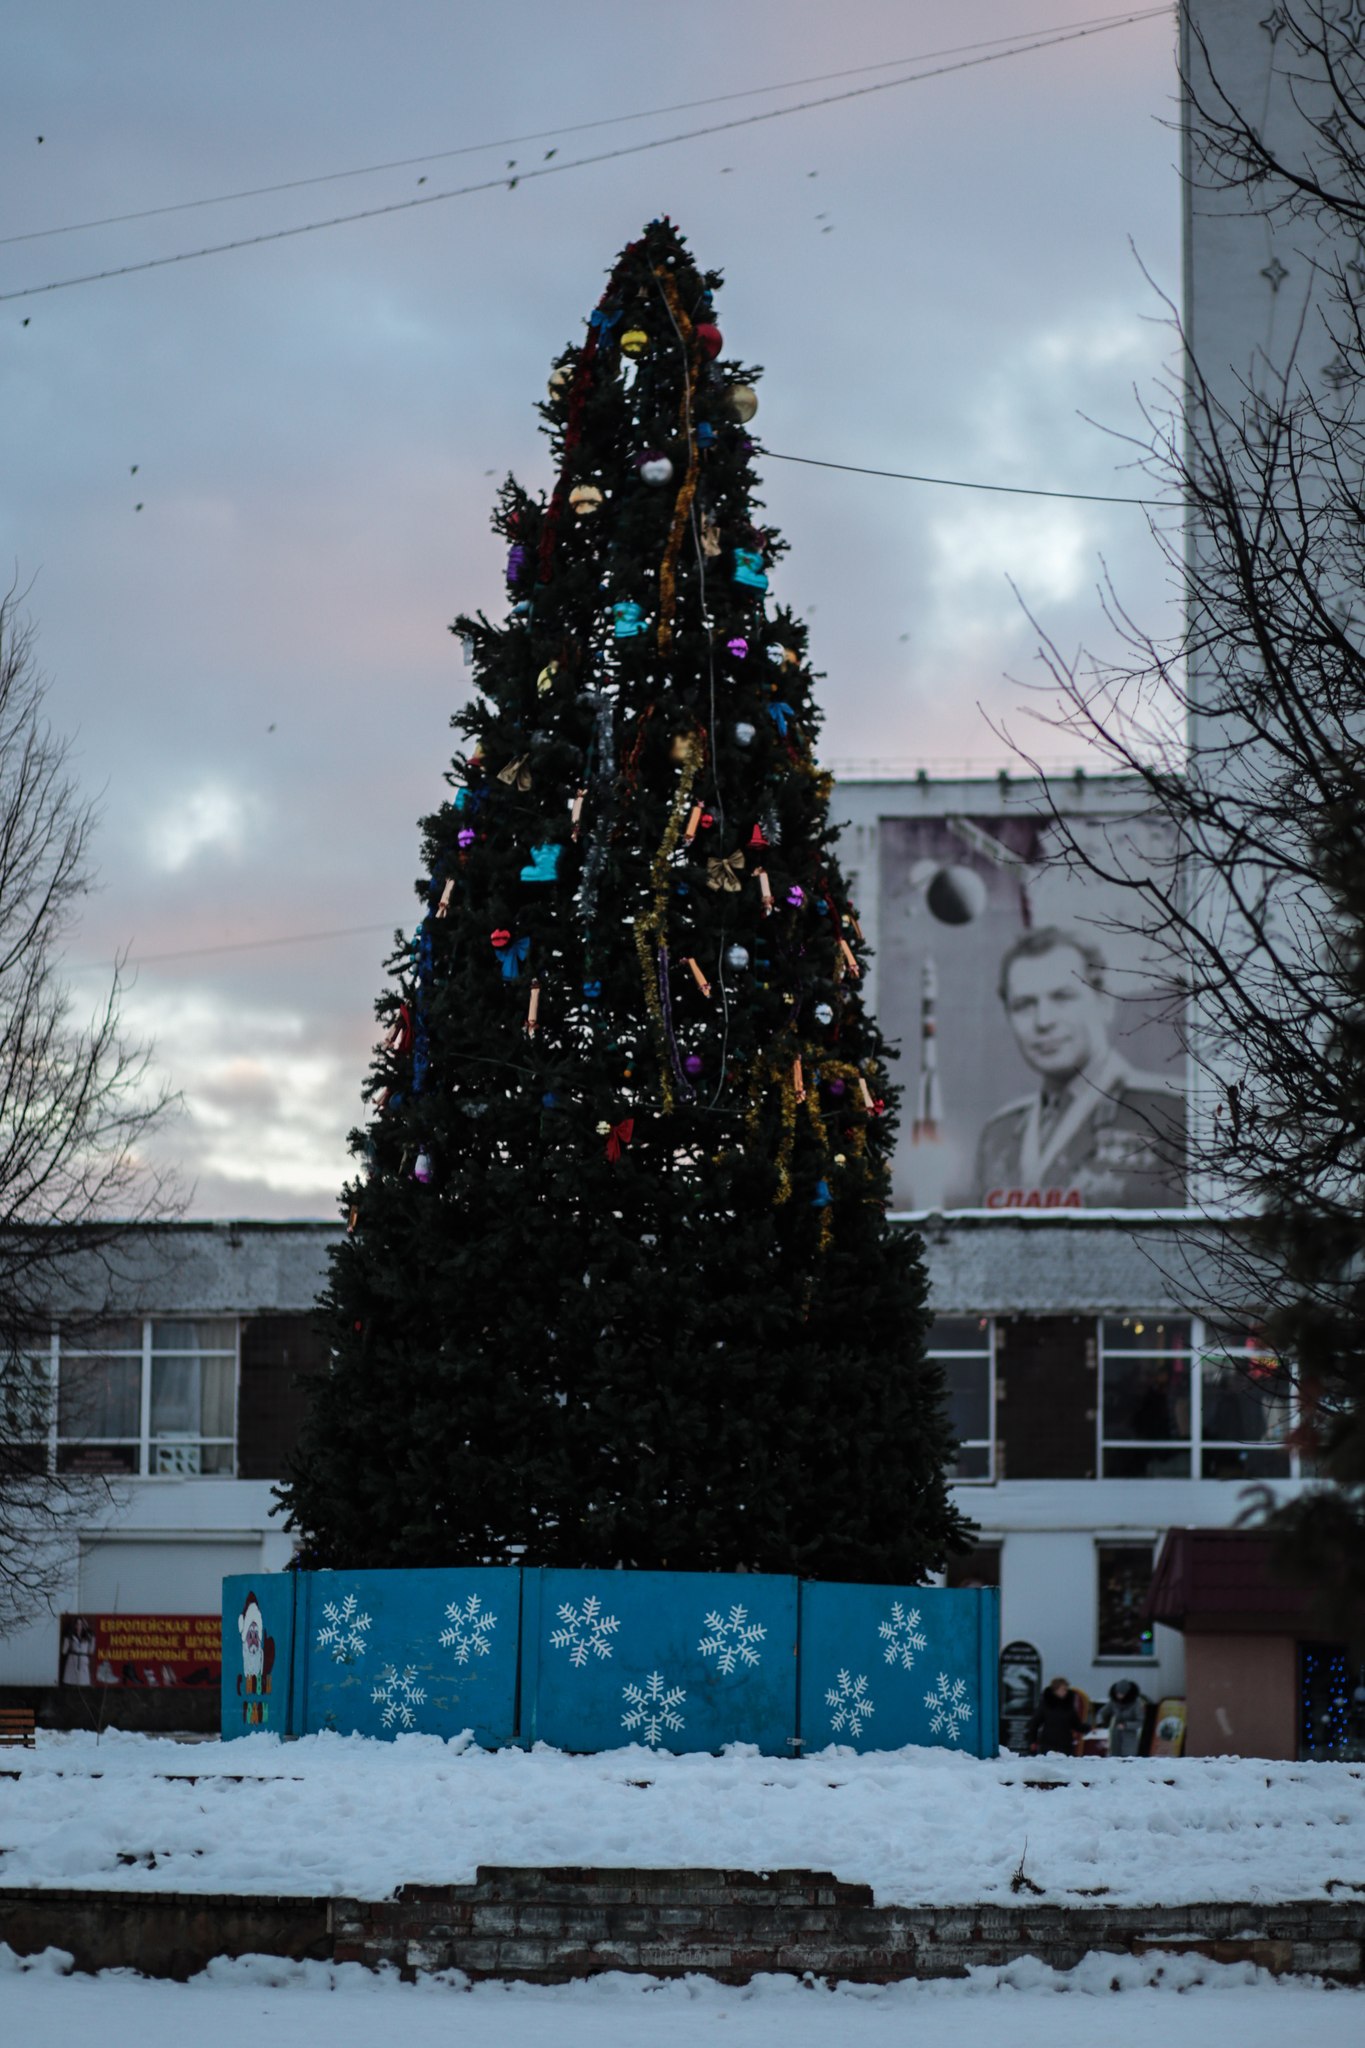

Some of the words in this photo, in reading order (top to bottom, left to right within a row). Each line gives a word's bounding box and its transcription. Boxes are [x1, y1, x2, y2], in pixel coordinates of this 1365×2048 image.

[986, 1189, 1081, 1208] СЛАВА
[100, 1618, 190, 1632] ЕВРОПЕЙСКАЯ
[110, 1634, 179, 1647] НОРКОВЫЕ
[97, 1648, 189, 1661] КАШЕМИРОВЫЕ
